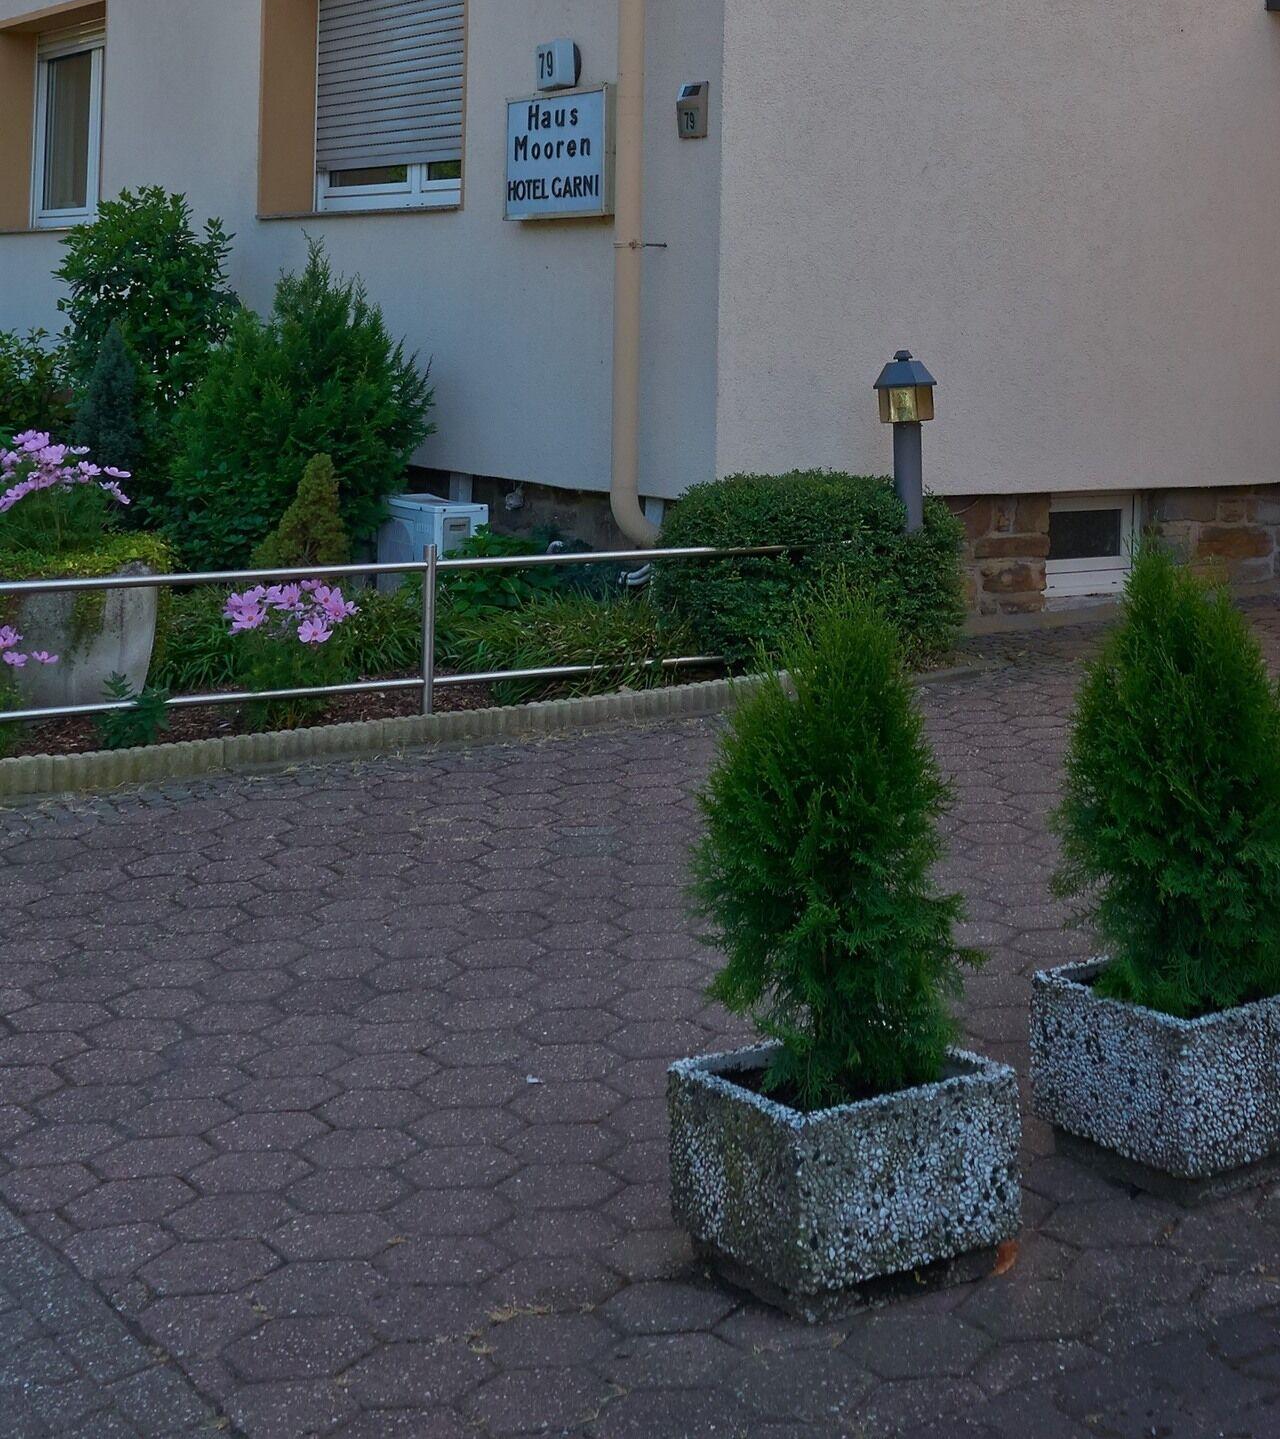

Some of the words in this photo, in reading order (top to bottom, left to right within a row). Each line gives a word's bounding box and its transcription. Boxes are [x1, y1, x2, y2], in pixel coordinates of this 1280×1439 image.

[538, 50, 554, 79] 79
[527, 103, 579, 131] Haus
[683, 111, 695, 130] 79
[514, 134, 591, 162] Mooren
[507, 177, 550, 202] HOTEL
[551, 174, 599, 198] GARNI
